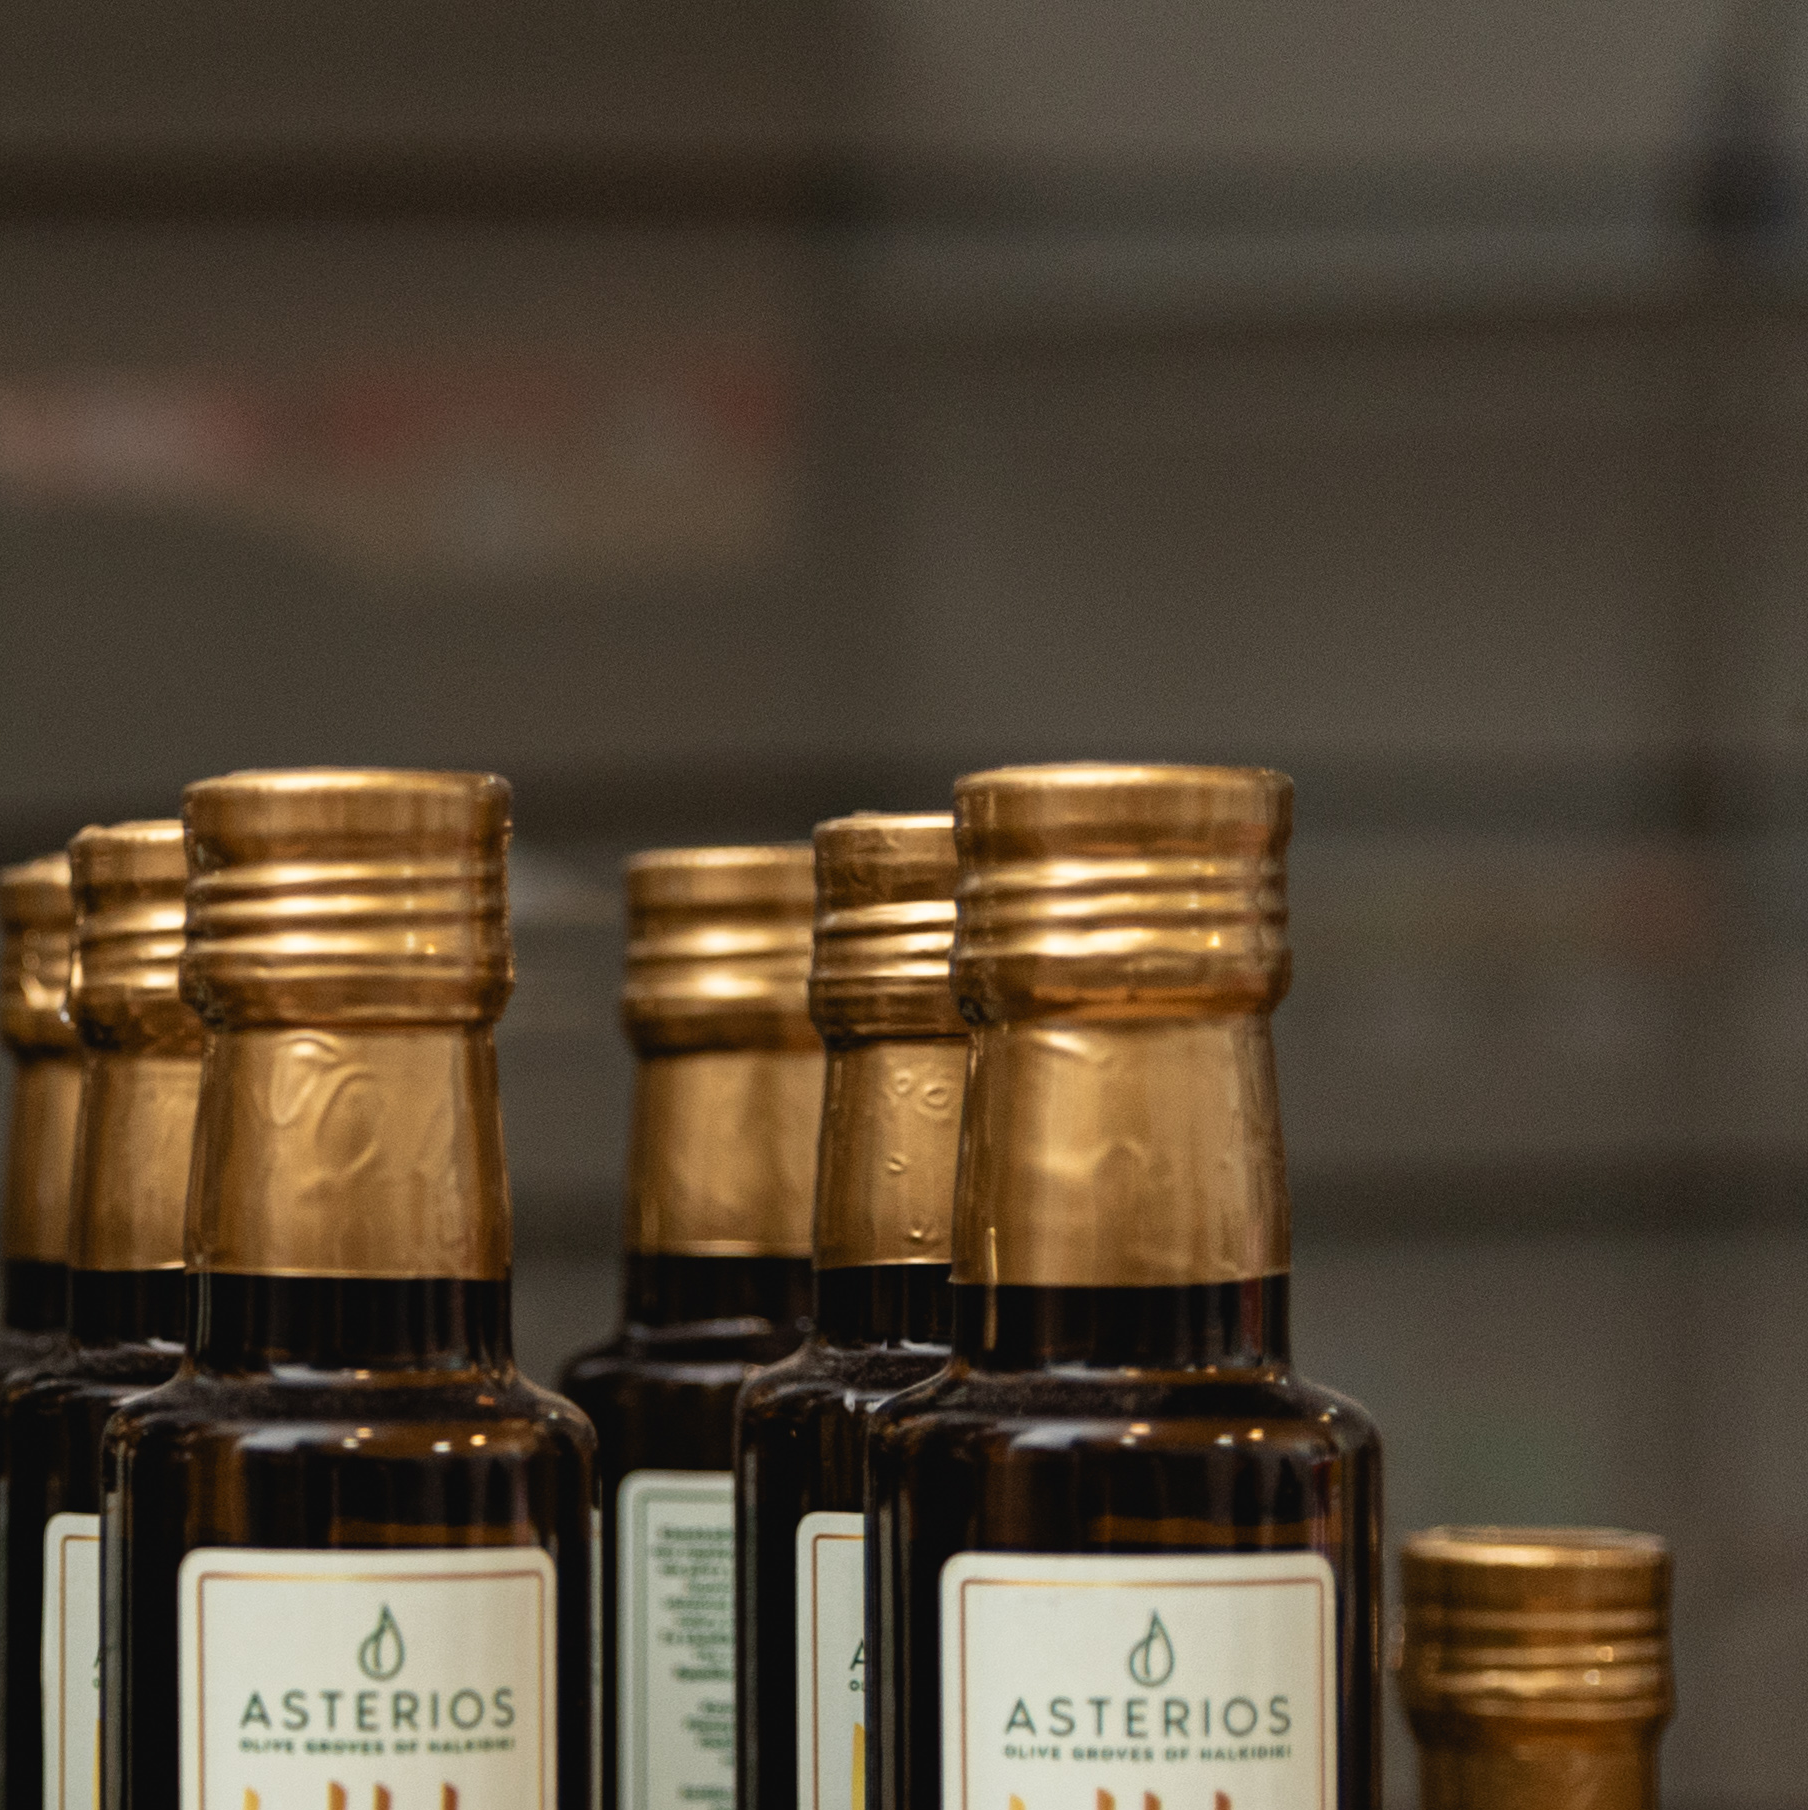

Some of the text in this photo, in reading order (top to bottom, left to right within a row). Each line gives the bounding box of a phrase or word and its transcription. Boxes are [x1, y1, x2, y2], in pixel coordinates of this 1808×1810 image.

[240, 1687, 516, 1732] ASTERIOS
[1005, 1697, 1290, 1737] ASTERIOS
[1004, 1744, 1060, 1760] OLIVE
